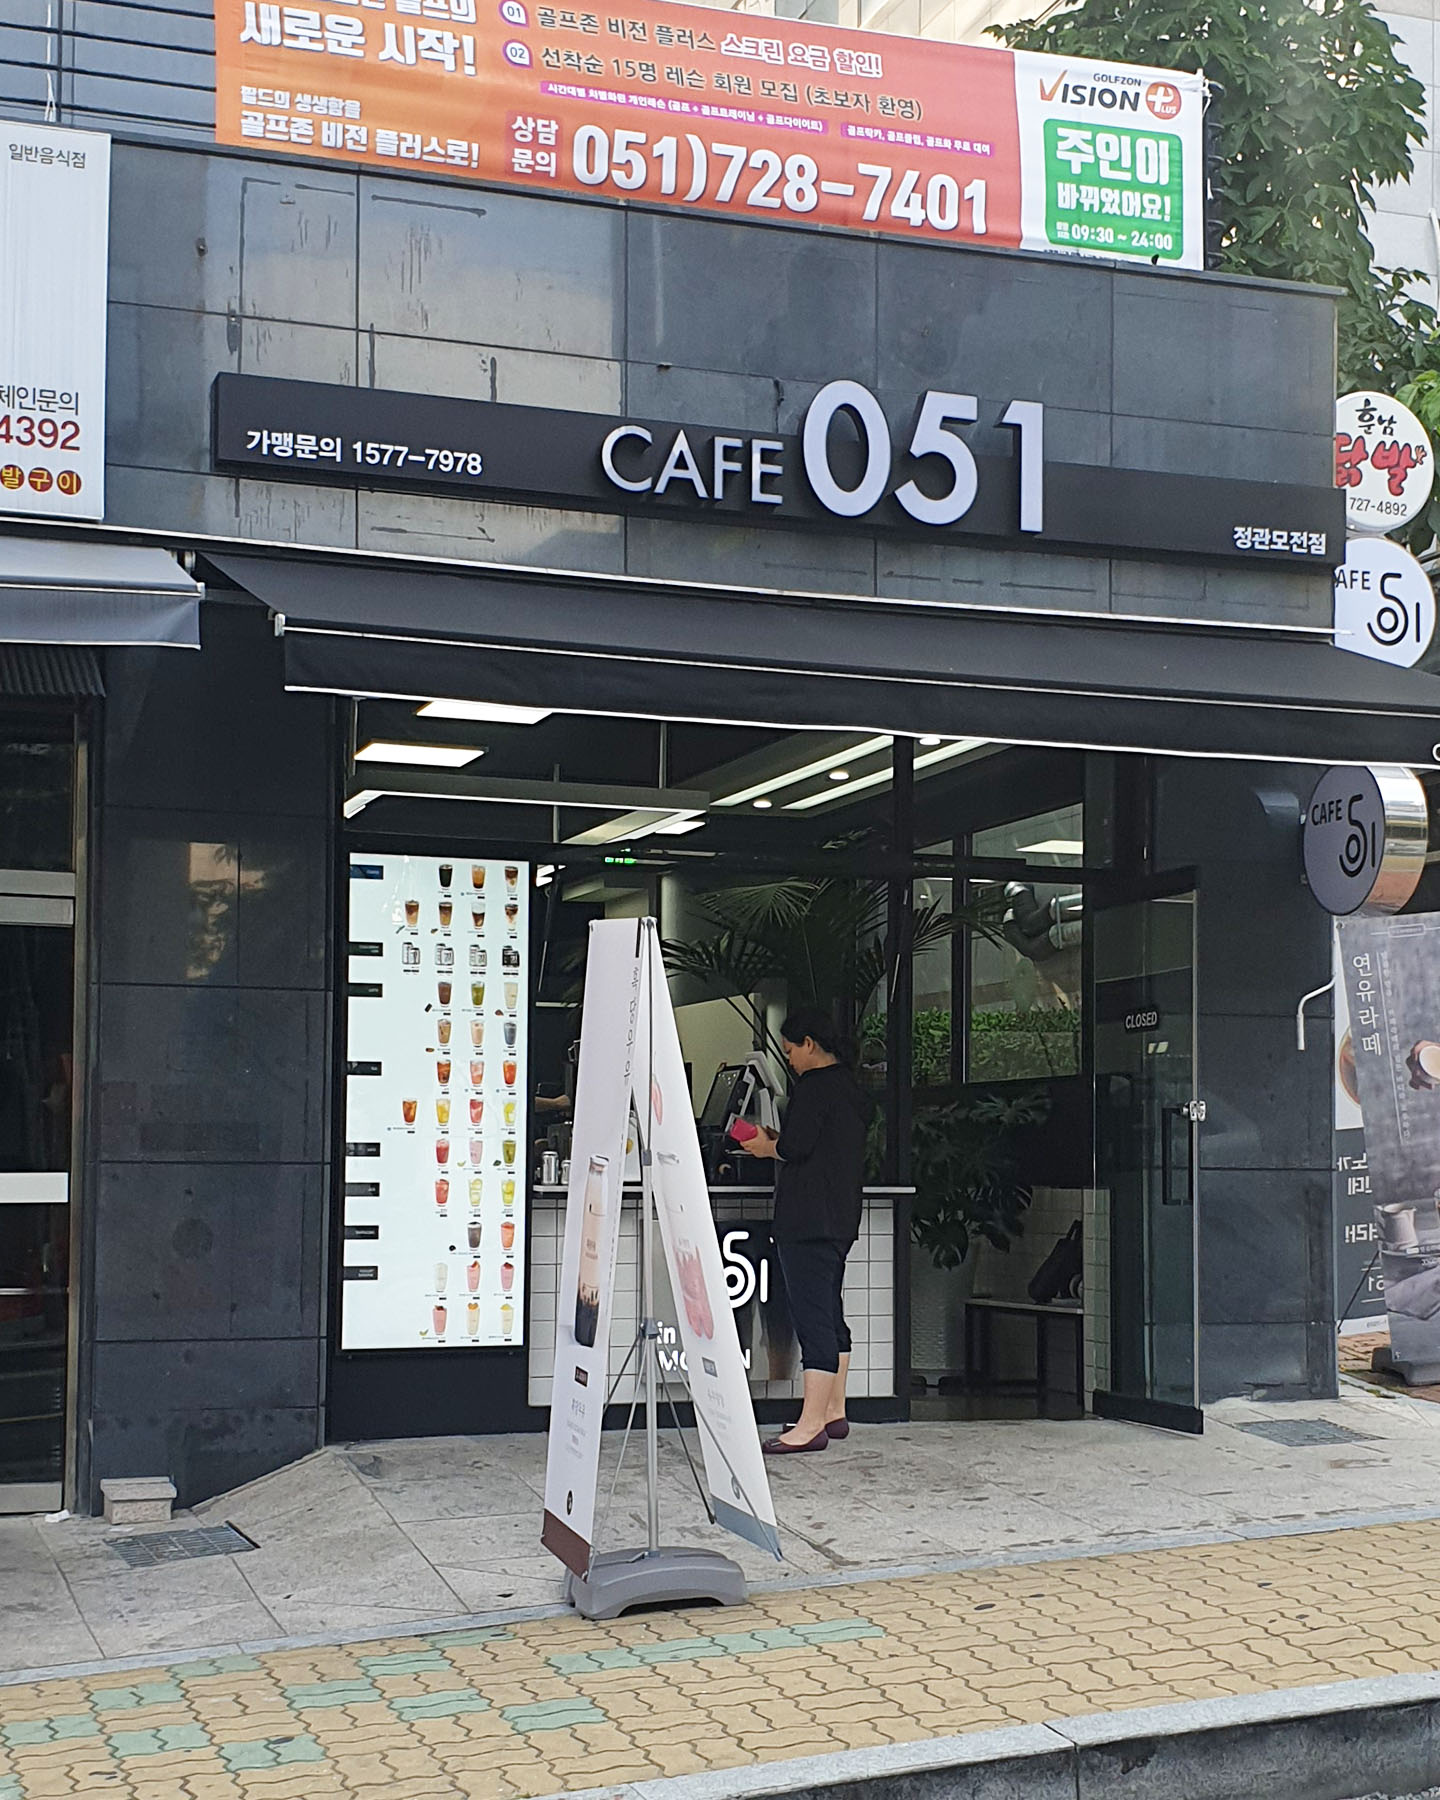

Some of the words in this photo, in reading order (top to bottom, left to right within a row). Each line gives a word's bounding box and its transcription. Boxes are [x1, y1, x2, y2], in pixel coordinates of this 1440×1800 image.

[240, 1, 365, 57] 새로운
[379, 22, 476, 76] 시작!
[507, 5, 521, 18] 01
[537, 6, 599, 34] 골프존
[608, 17, 647, 42] 비전
[655, 25, 716, 50] 플러스
[721, 33, 784, 65] 스크린
[788, 43, 830, 71] 요금
[833, 48, 883, 78] 할인!
[509, 46, 526, 59] 02
[541, 47, 604, 75] 선착순
[612, 58, 657, 83] 15명
[666, 65, 705, 89] 레슨
[714, 73, 752, 95] 회원
[760, 79, 798, 102] 모집
[806, 85, 870, 113] (초보자
[878, 95, 922, 121] 환영)
[1093, 73, 1142, 86] GOLFZON
[241, 110, 314, 144] 골프존
[321, 121, 368, 152] 비전
[375, 128, 480, 168] 플러스로!
[511, 116, 559, 146] 상담
[9, 143, 86, 169] 일반음식점
[511, 148, 557, 178] 문의
[1055, 127, 1169, 186] 주인이
[573, 124, 987, 235] 051)728-7401
[1056, 182, 1171, 222] 바뀌었어요!
[1071, 224, 1114, 244] 09:30
[1131, 231, 1173, 250] 24:00
[247, 430, 342, 463] 가맹문의
[352, 441, 483, 475] 1577-7978
[600, 424, 785, 506] CAFE
[802, 379, 1045, 533] 051
[1350, 497, 1407, 517] 727-4892
[1233, 526, 1326, 555] 정관모전점
[1335, 570, 1371, 590] AFE
[1311, 799, 1342, 827] CAFE
[1125, 1011, 1158, 1029] CLOSED
[1353, 953, 1381, 1056] 연유라떼
